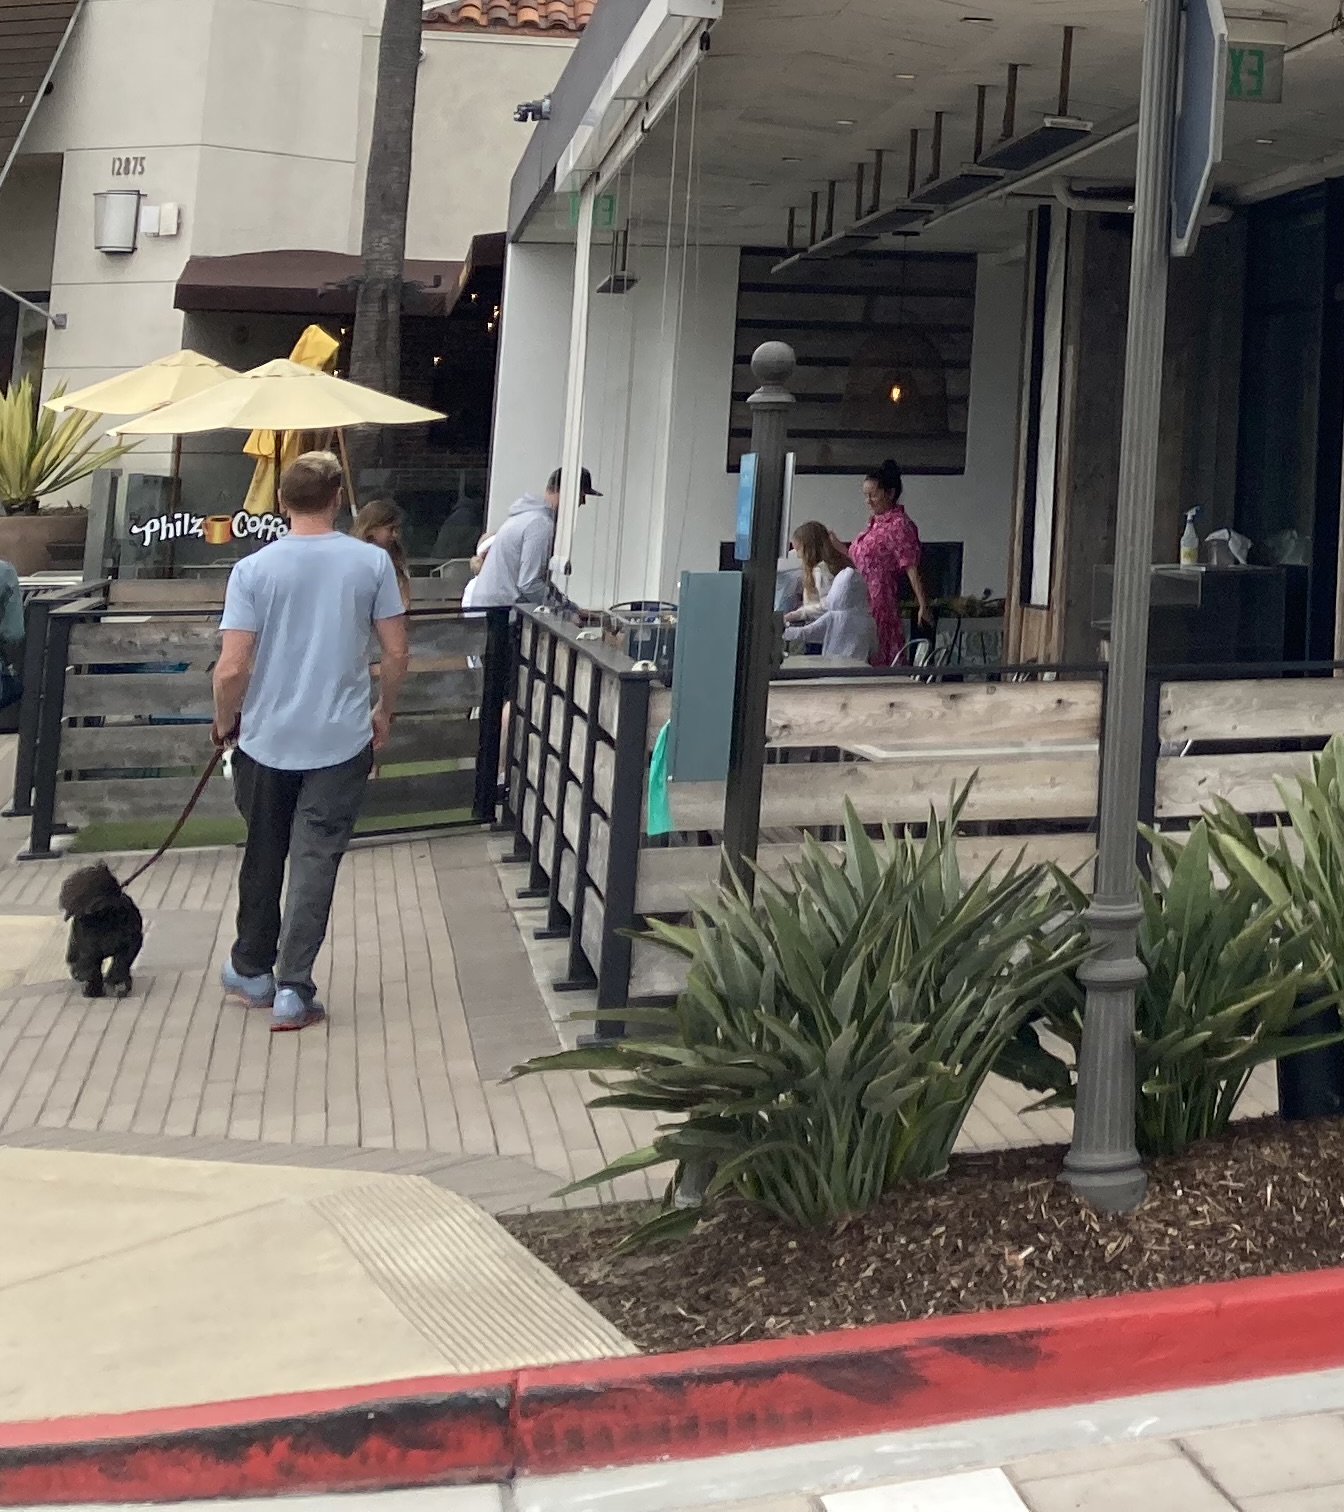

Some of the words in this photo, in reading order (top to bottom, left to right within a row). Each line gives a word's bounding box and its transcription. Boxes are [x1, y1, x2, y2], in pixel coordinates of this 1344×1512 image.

[109, 156, 147, 177] 12875
[131, 512, 204, 547] Philz
[231, 511, 289, 541] Coffe
